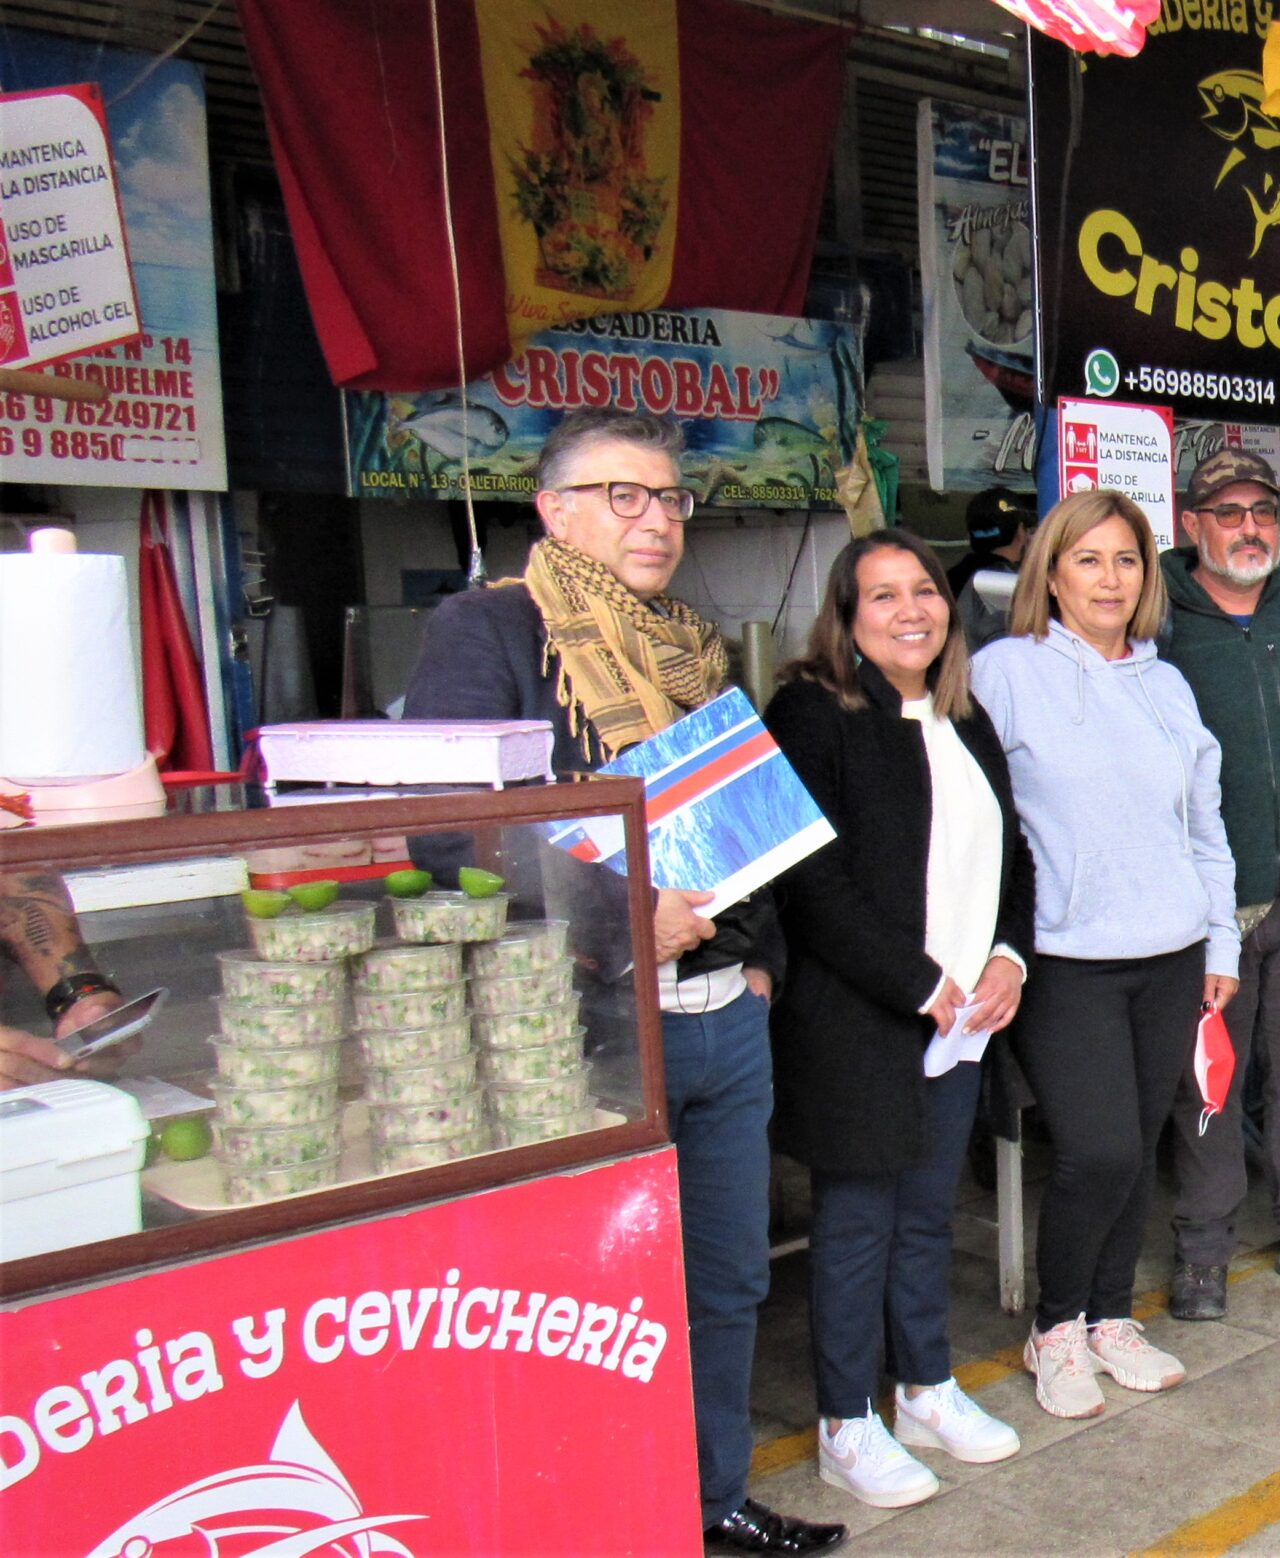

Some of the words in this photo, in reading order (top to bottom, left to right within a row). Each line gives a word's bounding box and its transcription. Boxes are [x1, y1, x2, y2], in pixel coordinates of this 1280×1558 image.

[0, 139, 88, 169] MANTENGA
[1, 180, 21, 199] LA
[24, 165, 108, 195] DISTANCIA
[7, 219, 42, 242] USO
[45, 214, 68, 235] DE
[13, 233, 114, 271] MASCARILLA
[22, 292, 56, 315] USO
[58, 286, 81, 307] DE
[29, 309, 101, 344] ALCOHOL
[103, 301, 133, 322] GEL
[161, 337, 193, 365] 14
[1125, 366, 1275, 405] +56988503314
[34, 395, 54, 423] 9
[64, 398, 196, 432] 76249721
[22, 428, 43, 458] 9
[1100, 432, 1158, 446] MANTENGA
[1100, 450, 1113, 460] LA
[1115, 451, 1168, 464] DISTANCIA
[362, 472, 405, 488] LOCAL
[431, 475, 448, 488] 13
[459, 475, 505, 490] CALETA
[752, 486, 805, 501] 88503314
[1100, 474, 1122, 485] USO
[1124, 475, 1138, 486] DE
[232, 1307, 286, 1379] y
